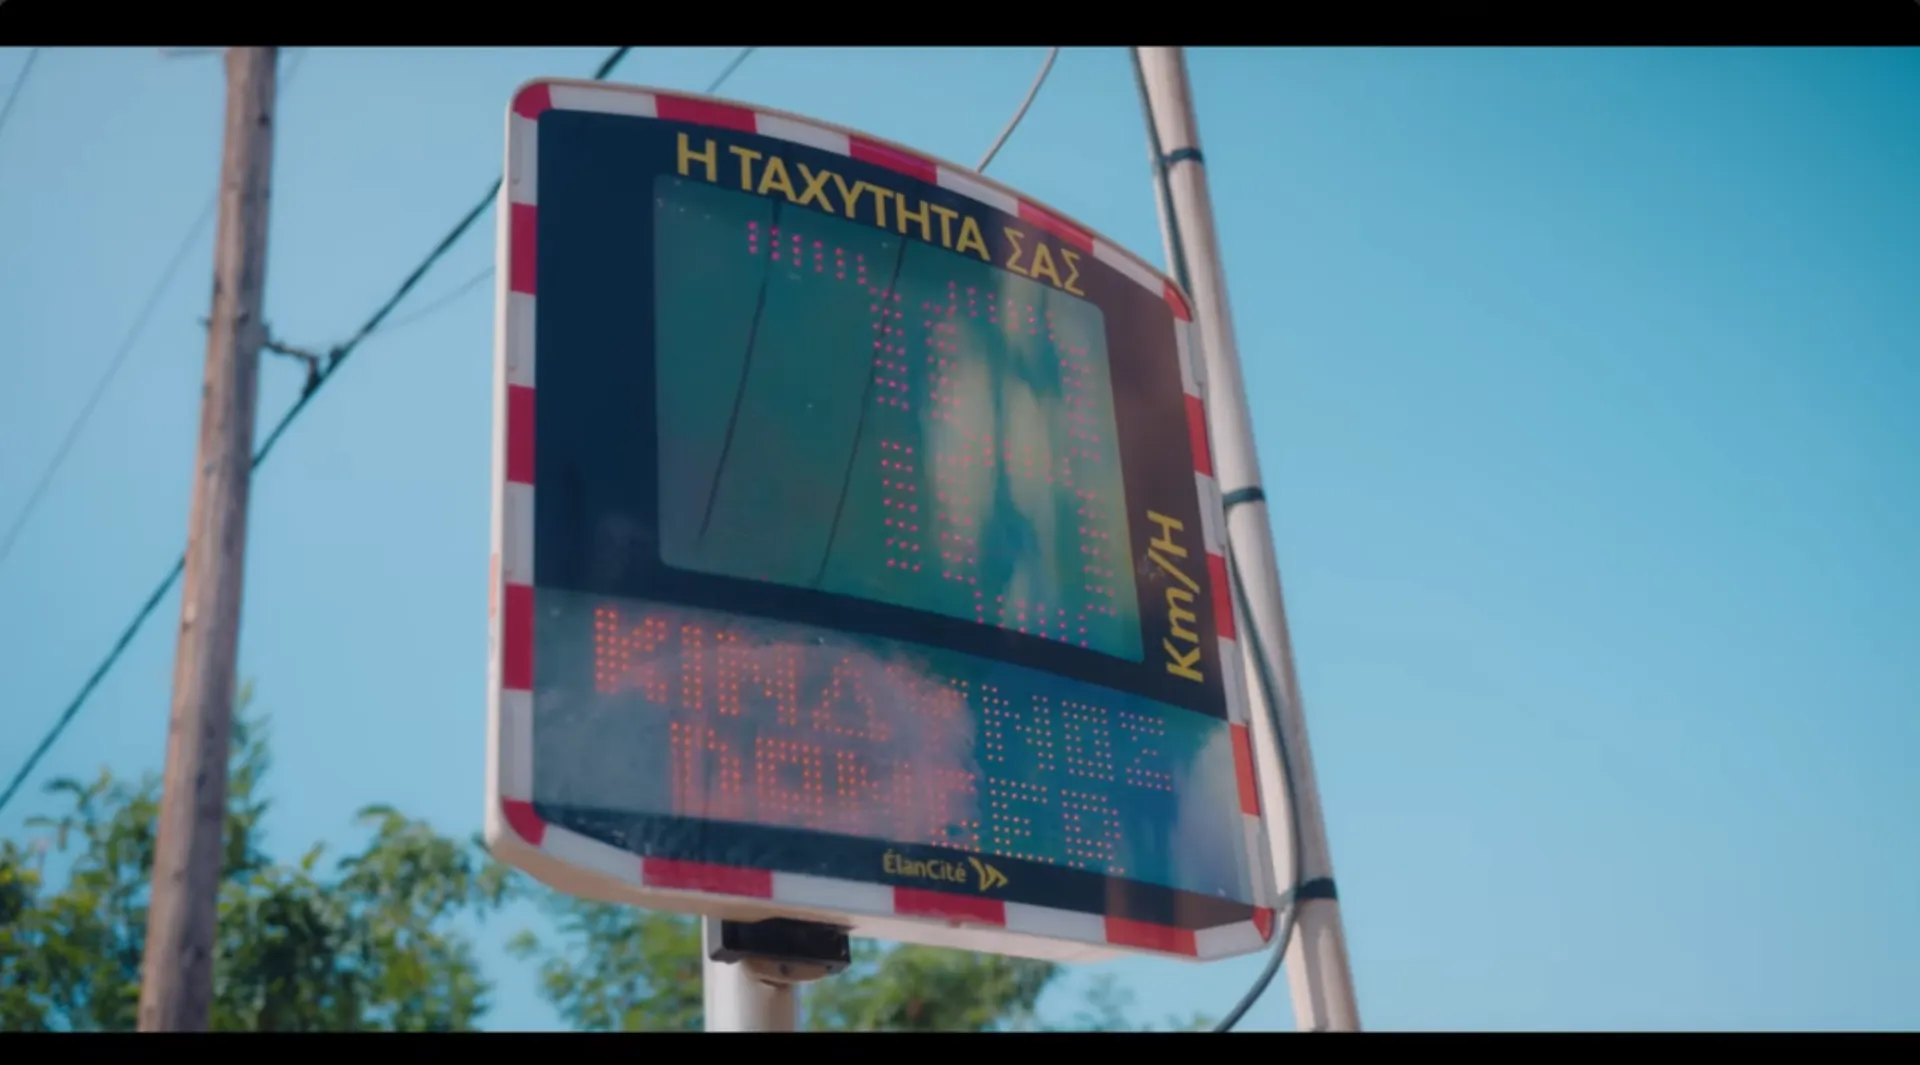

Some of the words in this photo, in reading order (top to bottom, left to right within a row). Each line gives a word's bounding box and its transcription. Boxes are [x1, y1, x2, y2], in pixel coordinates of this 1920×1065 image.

[677, 132, 717, 183] Η
[729, 145, 991, 261] ΤΑΧΥΤΗΤΑ
[1003, 226, 1085, 297] ΣΑΣ
[1146, 509, 1204, 683] Km/H
[882, 848, 967, 883] ÉlanCité
